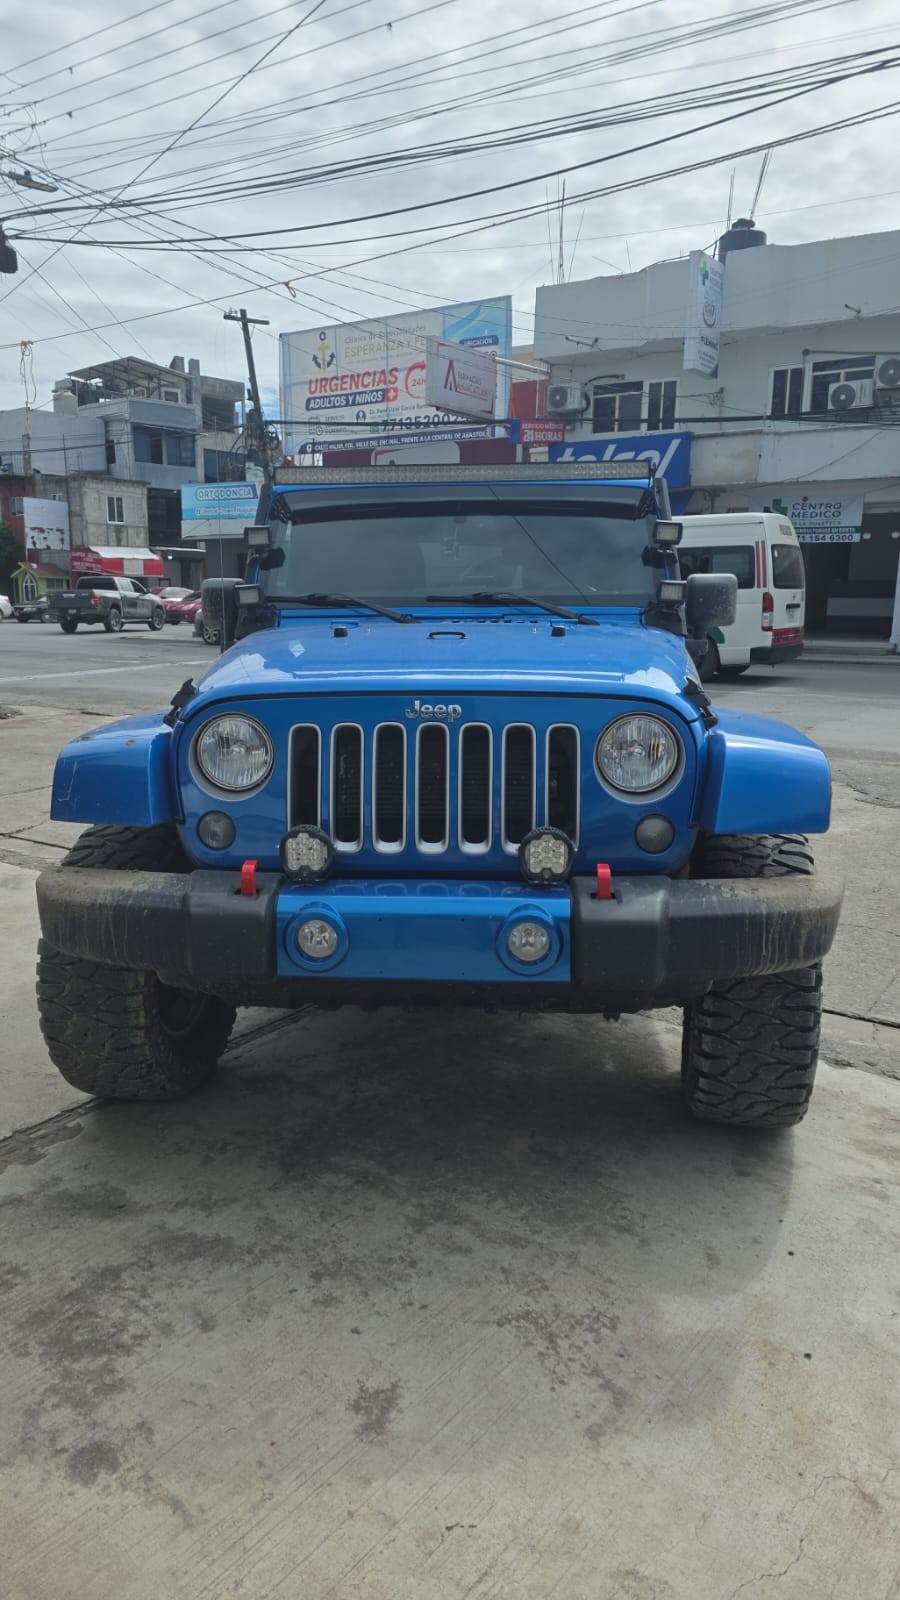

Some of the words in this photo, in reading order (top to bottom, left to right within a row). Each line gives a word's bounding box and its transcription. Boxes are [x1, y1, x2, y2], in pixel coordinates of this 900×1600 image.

[308, 367, 399, 395] URGENCIAS
[309, 396, 346, 409] ADULTOS
[347, 395, 355, 404] Y
[355, 390, 383, 403] NIÑOS
[535, 432, 563, 442] HORAS
[198, 486, 253, 499] ORTODONCIA
[792, 502, 842, 511] CENTRO
[405, 699, 462, 722] Jeep
